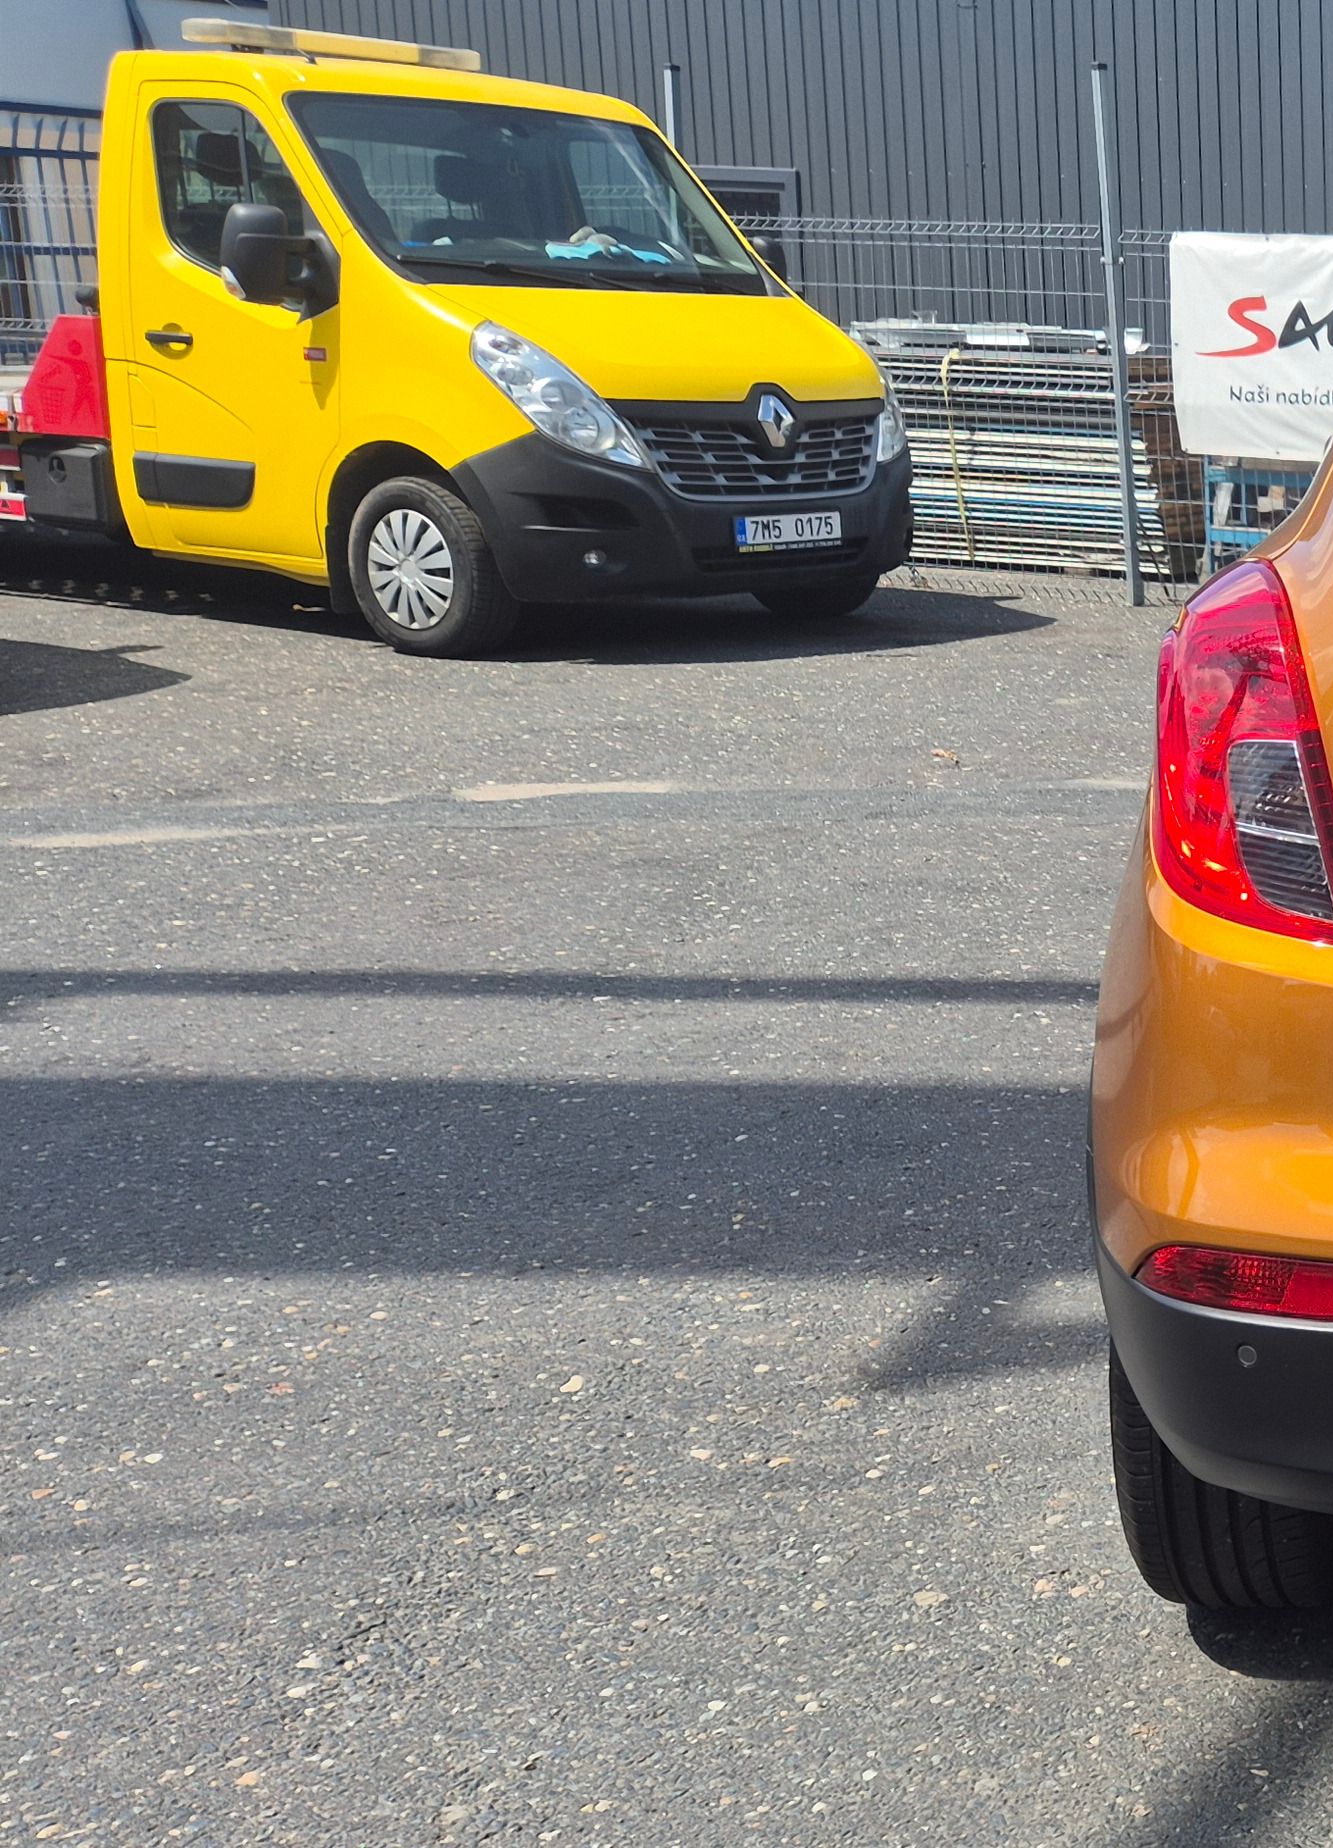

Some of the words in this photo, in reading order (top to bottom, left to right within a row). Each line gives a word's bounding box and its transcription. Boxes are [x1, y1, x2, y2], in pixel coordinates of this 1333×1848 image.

[1229, 384, 1270, 404] Naši
[750, 519, 782, 541] 7M5
[795, 516, 833, 537] 0175
